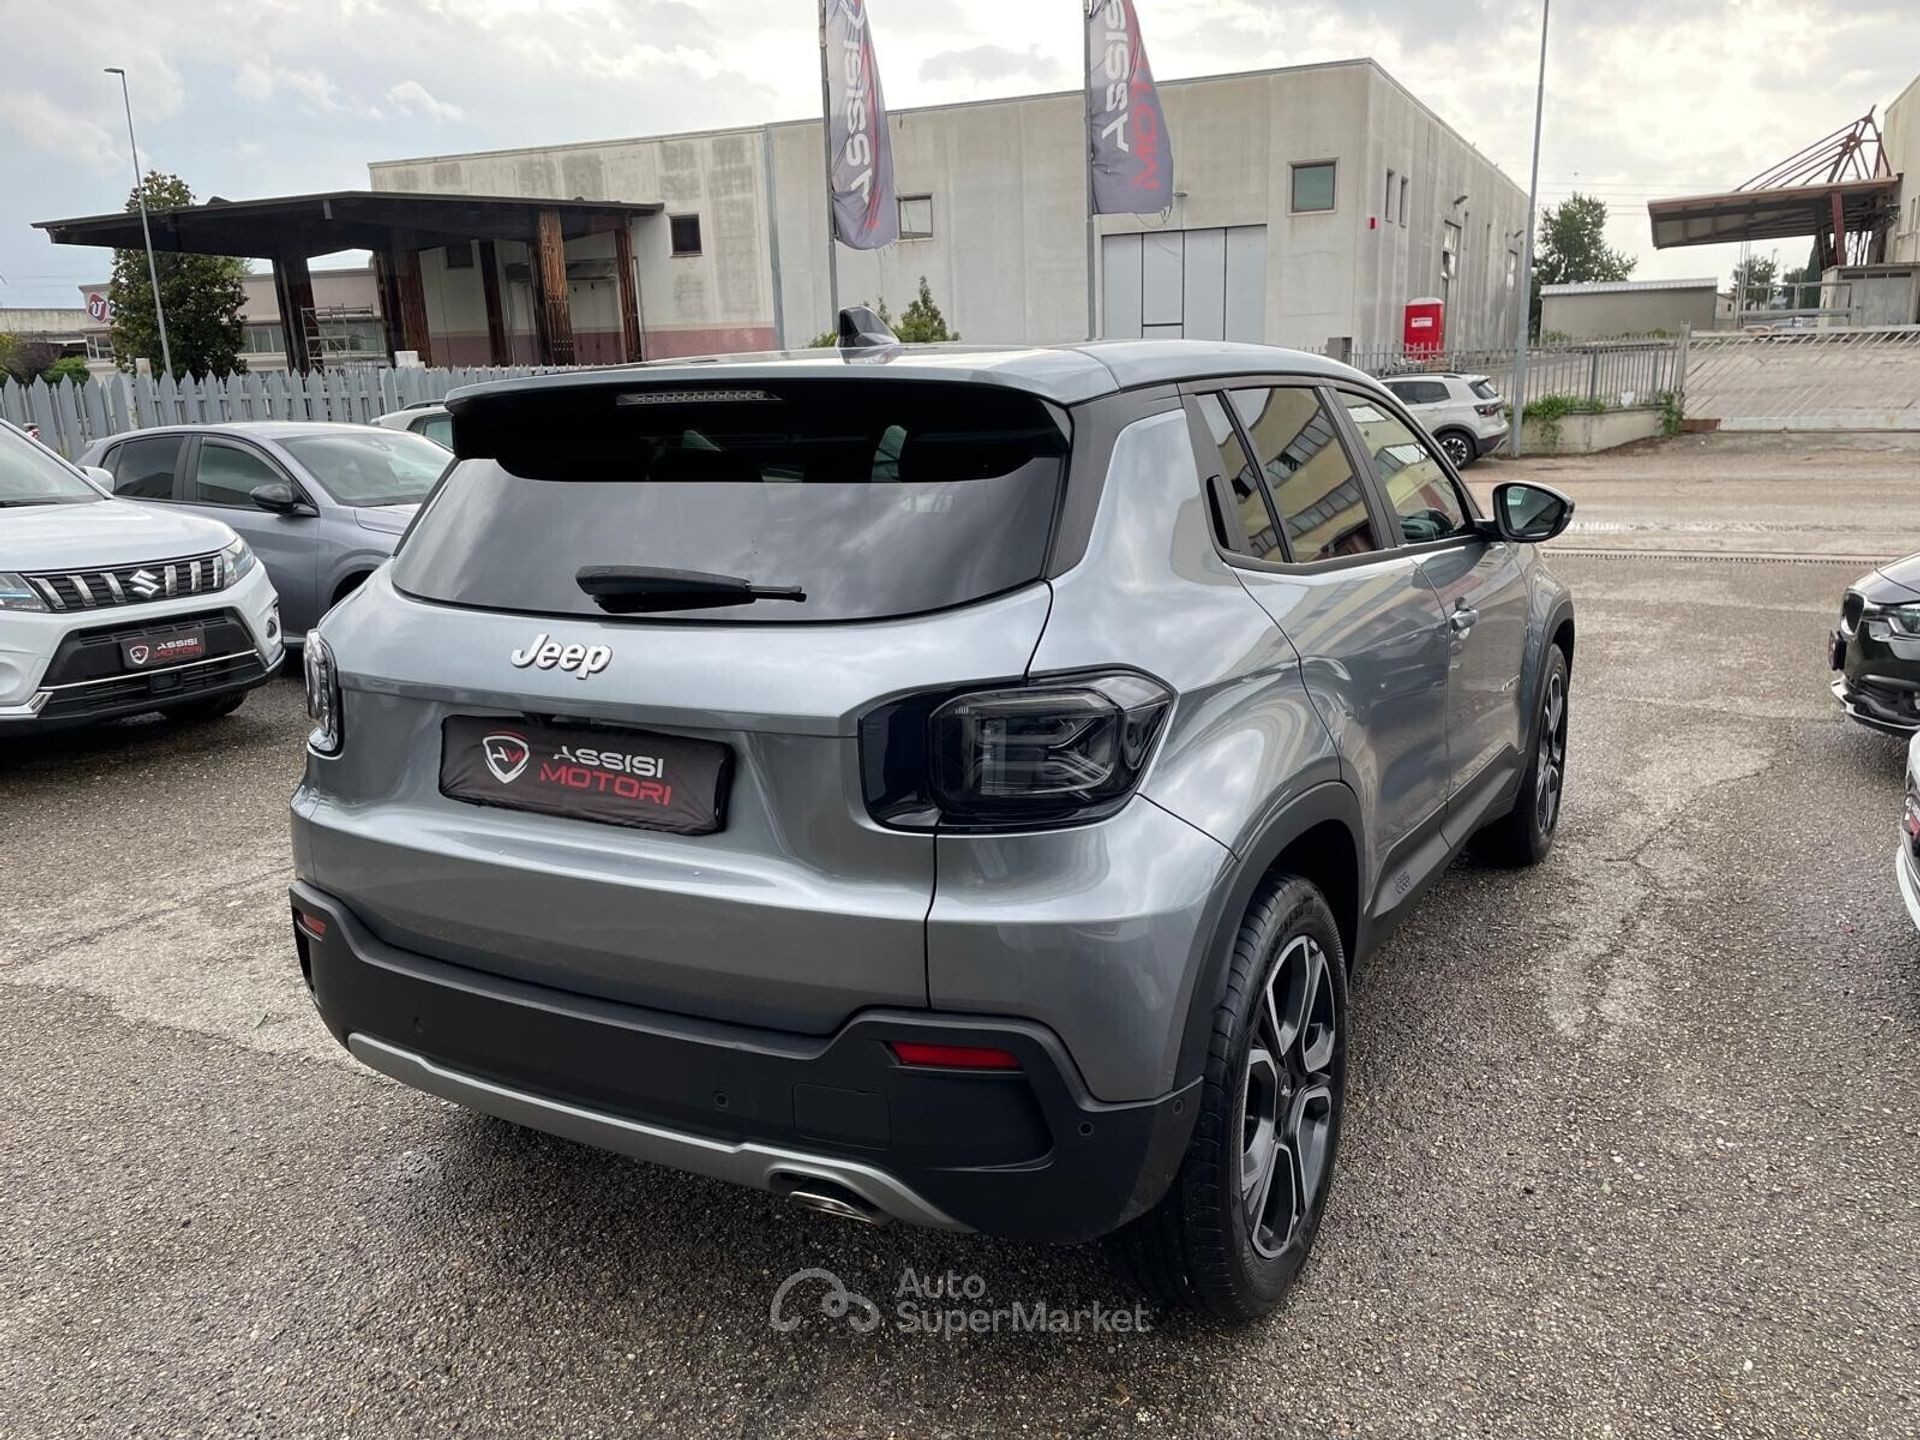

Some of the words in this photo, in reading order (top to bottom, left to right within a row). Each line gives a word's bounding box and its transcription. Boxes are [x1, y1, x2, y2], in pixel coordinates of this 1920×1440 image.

[1101, 0, 1130, 153] ASSIS
[843, 39, 873, 206] ASSISI
[156, 638, 198, 650] ASSISI
[511, 633, 613, 680] Jeep
[552, 745, 664, 778] ASSISI
[539, 763, 672, 806] MOTORI
